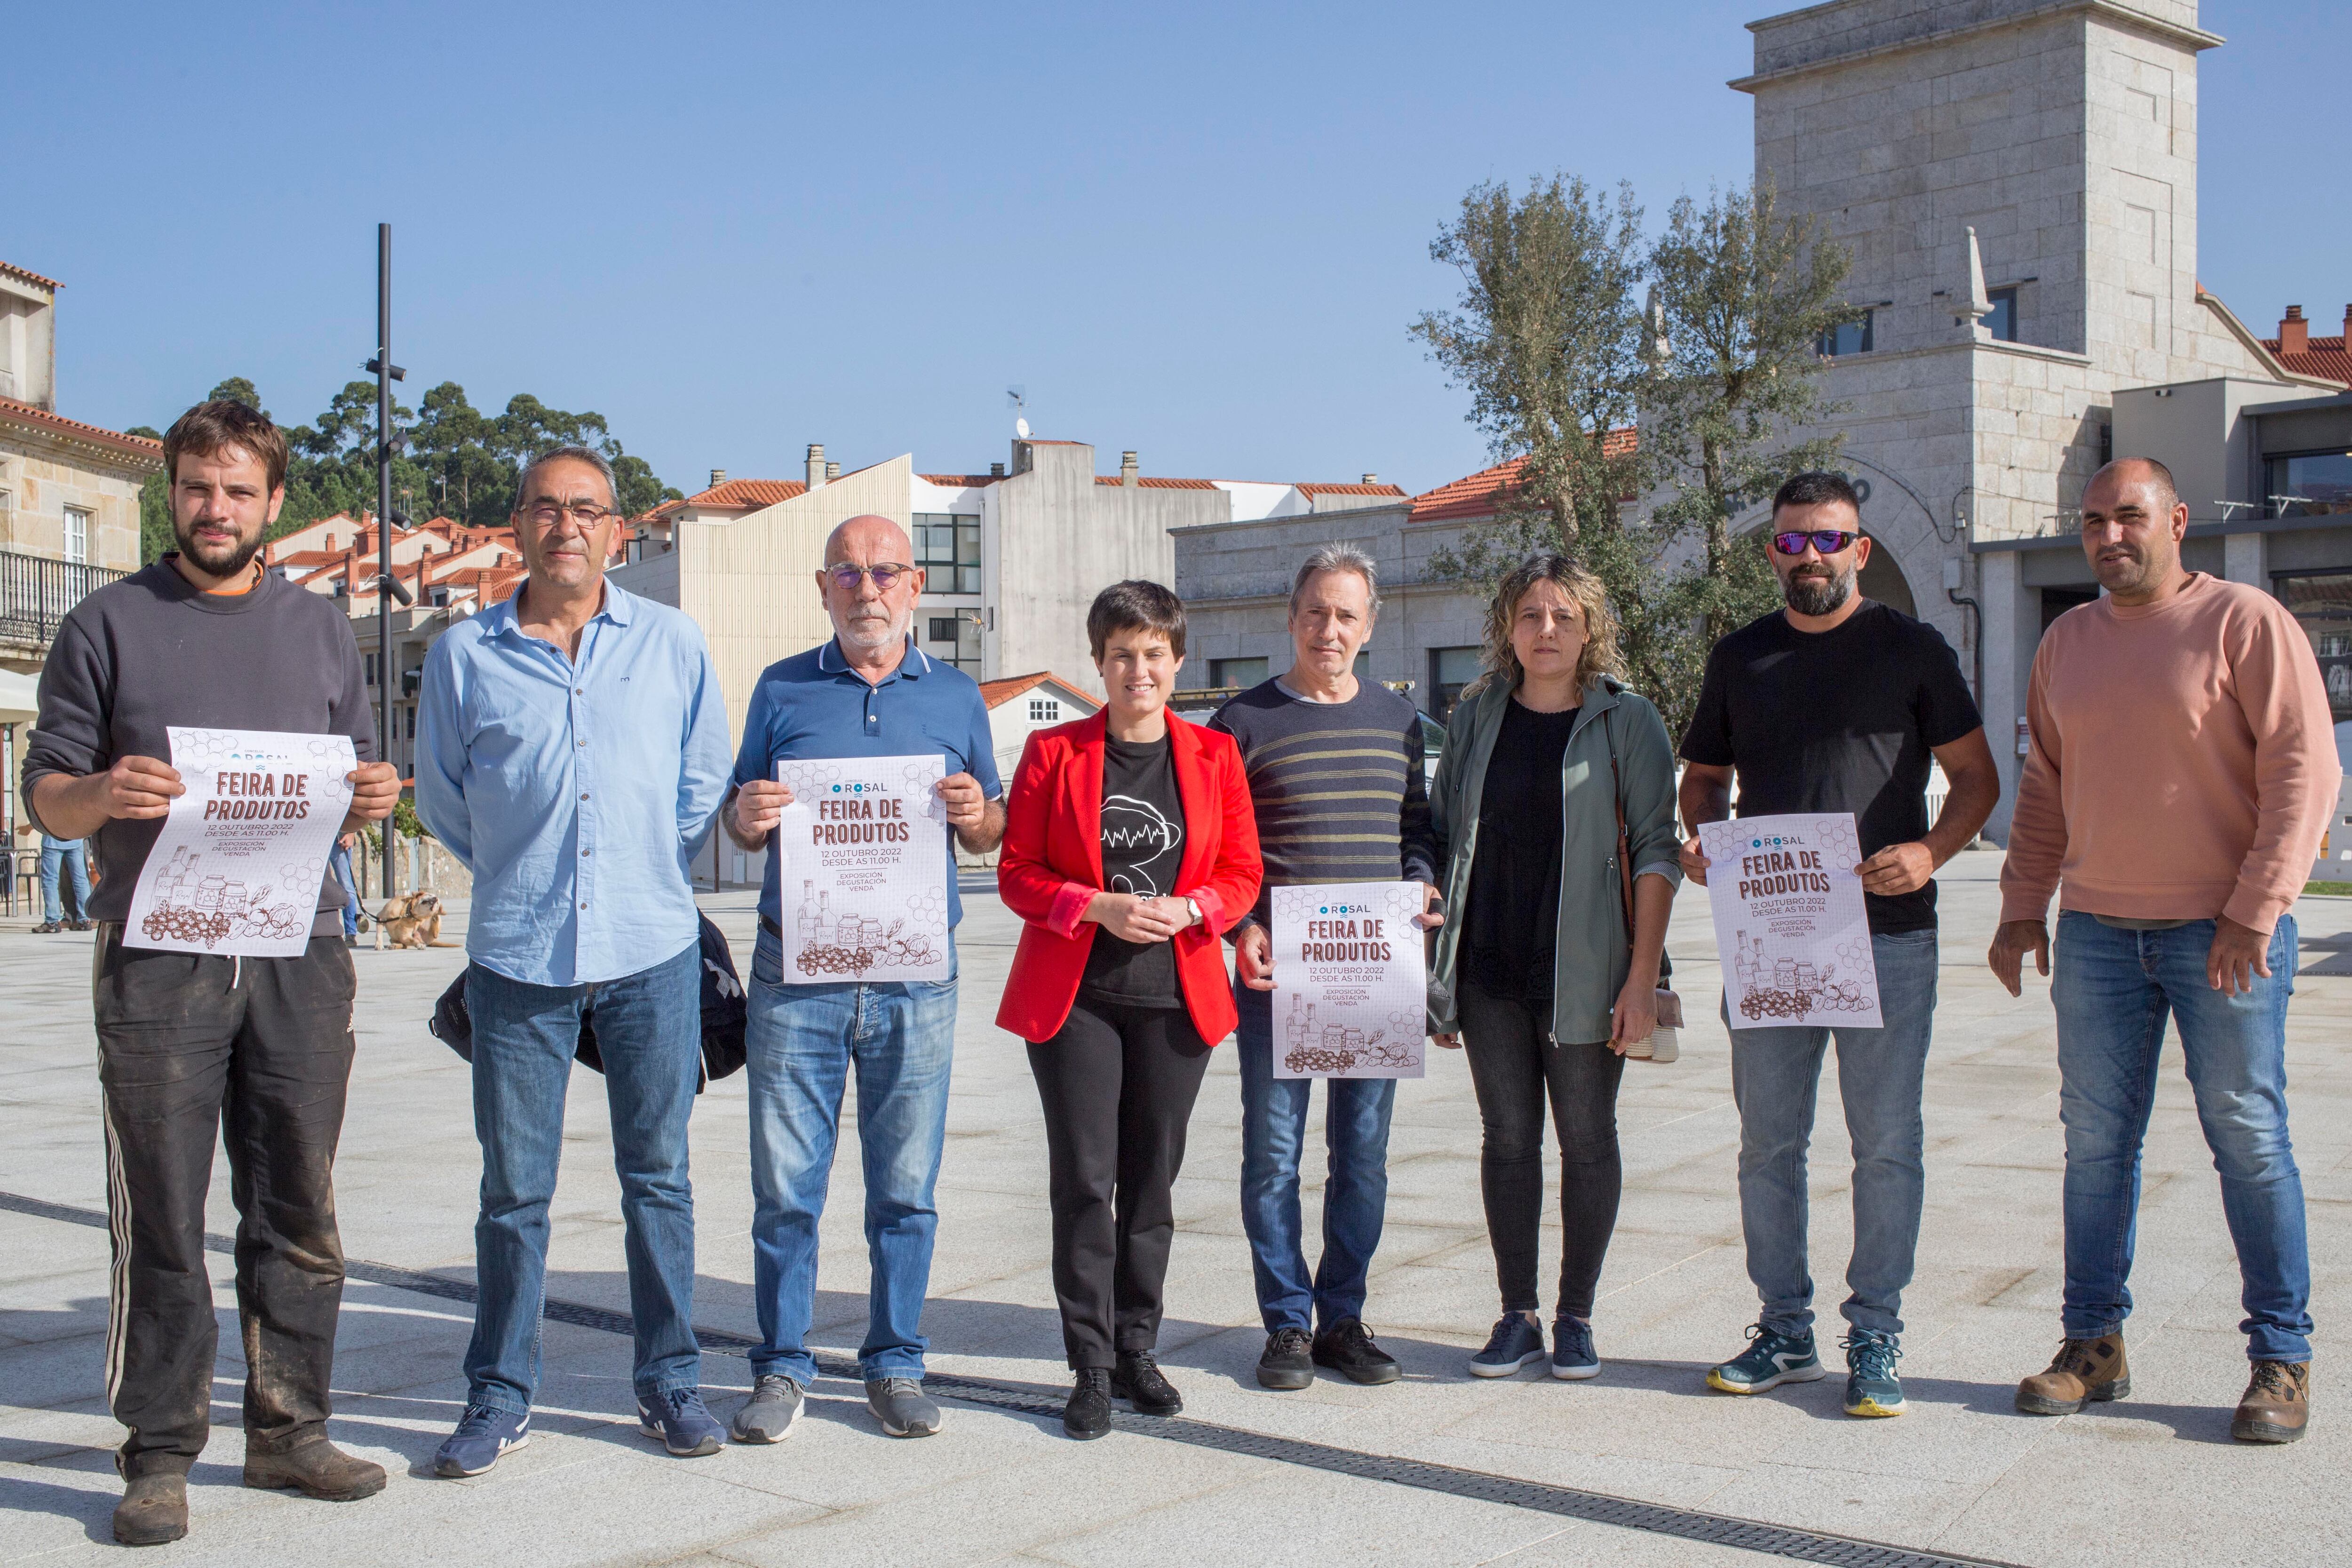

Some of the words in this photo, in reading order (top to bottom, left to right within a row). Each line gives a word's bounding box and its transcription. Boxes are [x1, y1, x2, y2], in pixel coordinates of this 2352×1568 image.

[216, 772, 275, 797] FEIRA
[282, 774, 309, 797] DE
[845, 782, 888, 793] ROSAL
[203, 800, 311, 820] PRODUTOS
[819, 800, 874, 820] FEIRA
[879, 799, 903, 819] DE
[813, 821, 910, 846] PRODUTOS
[1764, 837, 1805, 846] ROSAL
[1742, 852, 1796, 877] FEIRA
[1799, 851, 1823, 869] DE
[1739, 873, 1831, 900] PRODUTOS
[1331, 905, 1371, 914] ROSAL
[1752, 907, 1783, 917] DESDE
[1761, 898, 1805, 908] OUTUBRO
[1308, 920, 1358, 939] FEIRA
[1364, 919, 1384, 939] DE
[1302, 942, 1391, 962] PRODUTOS
